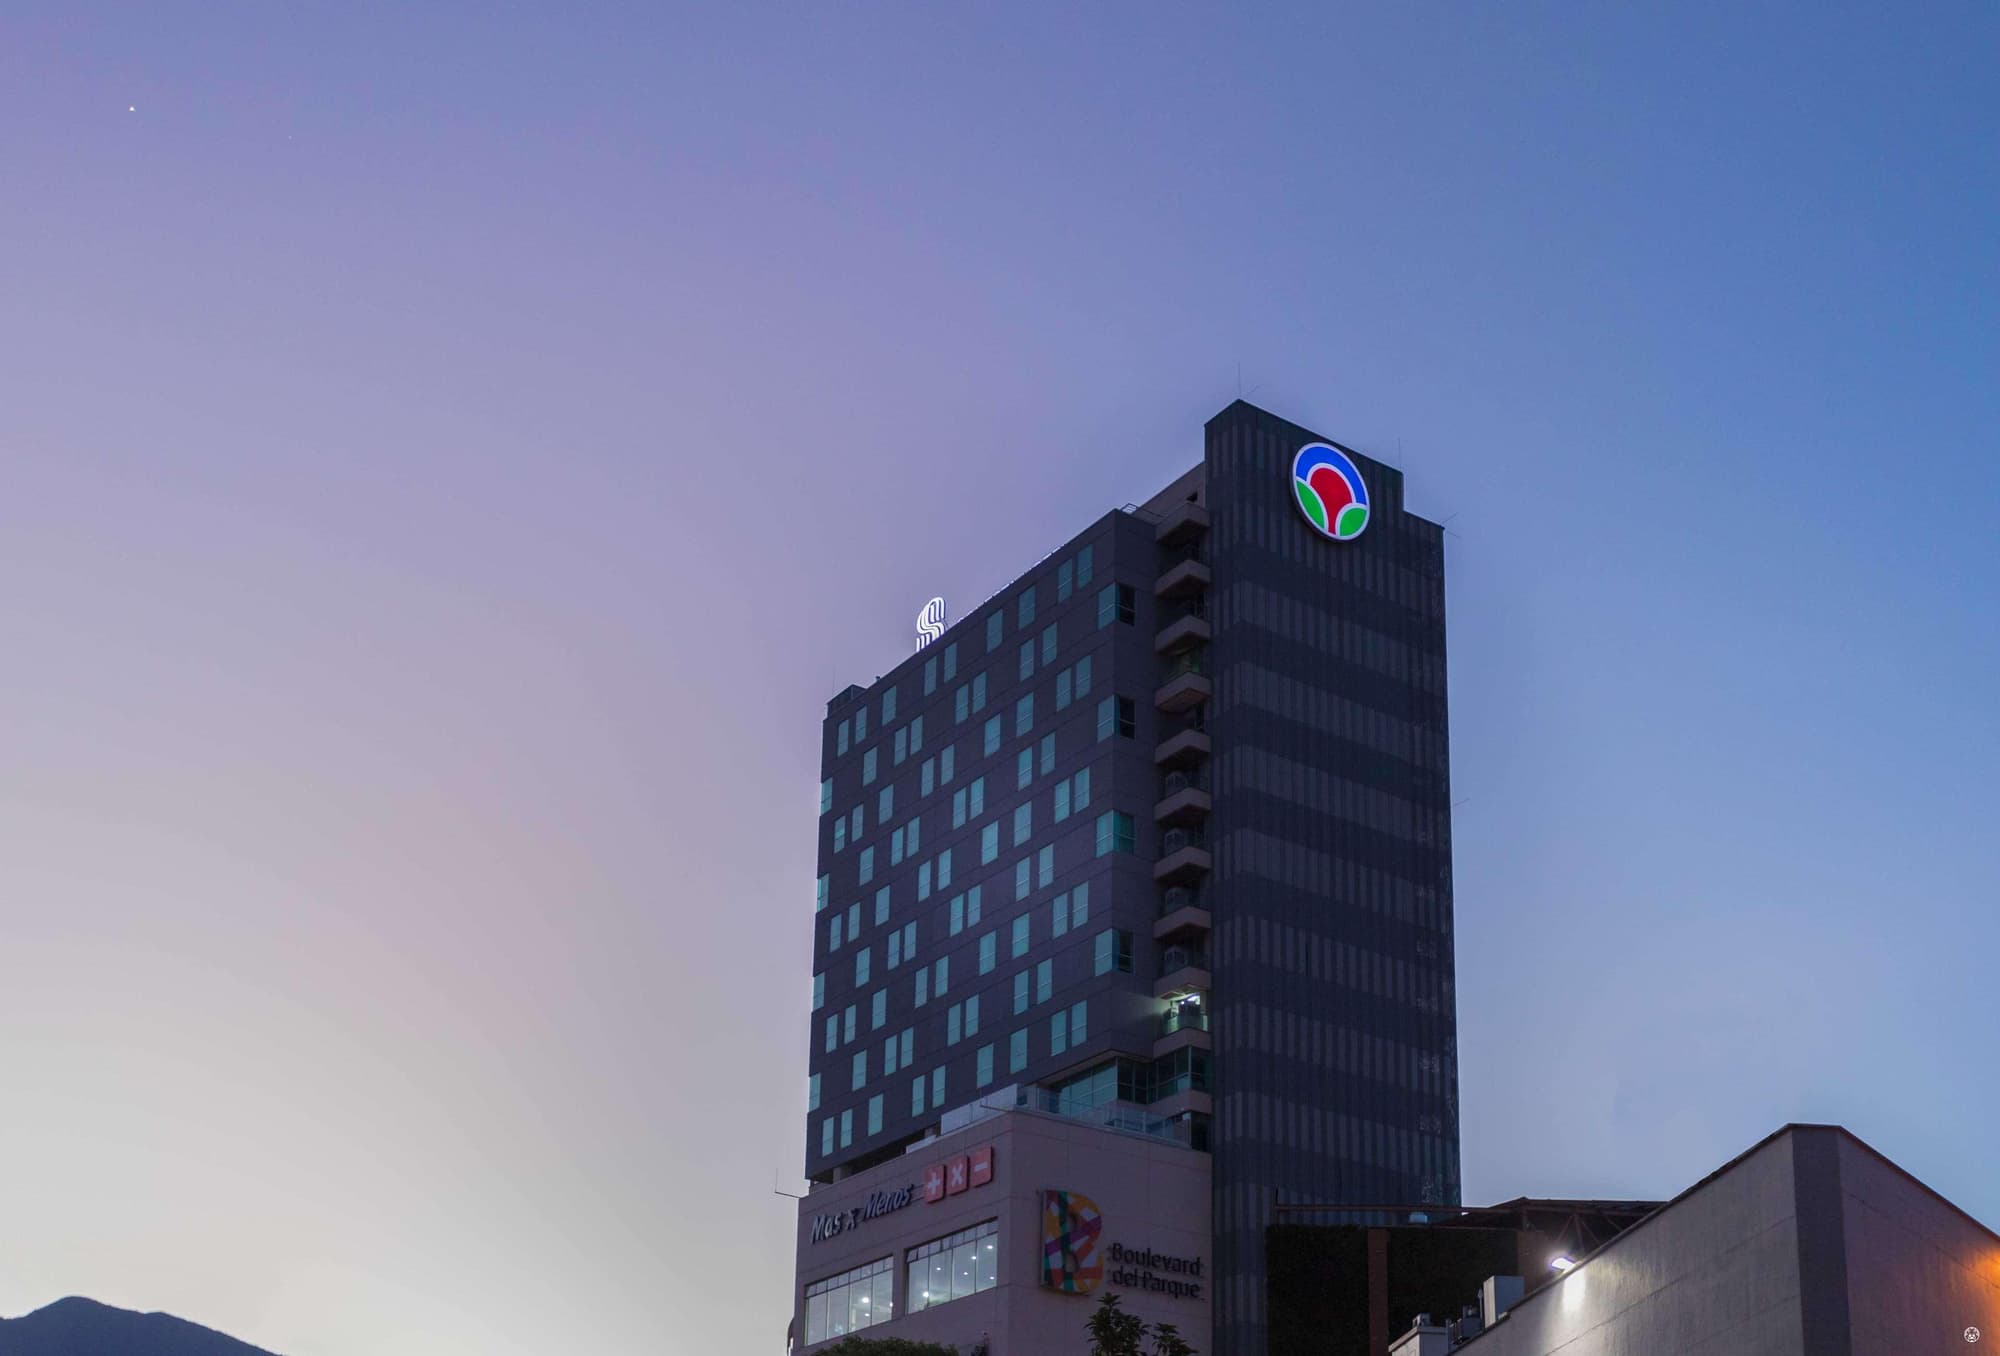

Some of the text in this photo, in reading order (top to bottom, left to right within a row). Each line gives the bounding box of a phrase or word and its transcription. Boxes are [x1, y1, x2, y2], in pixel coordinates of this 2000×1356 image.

[811, 1214, 841, 1245] Mas
[863, 1184, 914, 1219] Menos
[1111, 1243, 1200, 1276] Boulevard
[1111, 1266, 1200, 1299] del Parque
